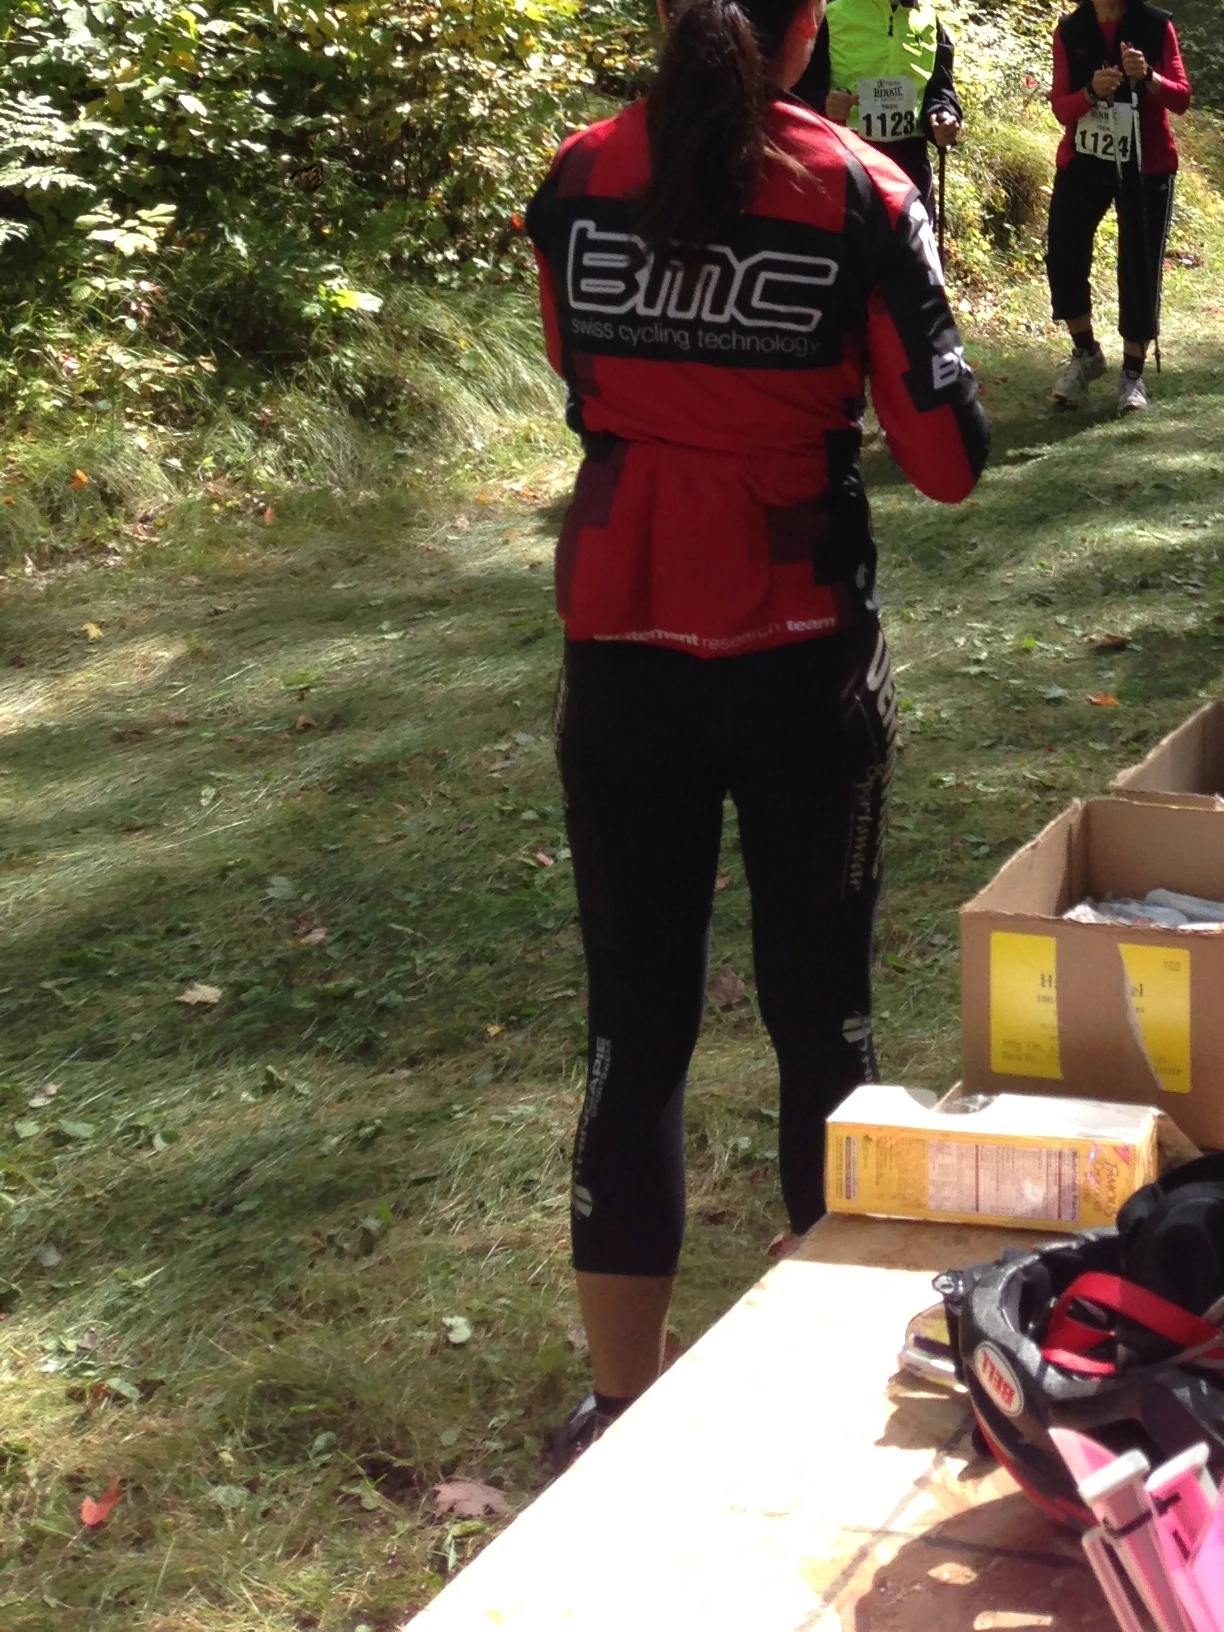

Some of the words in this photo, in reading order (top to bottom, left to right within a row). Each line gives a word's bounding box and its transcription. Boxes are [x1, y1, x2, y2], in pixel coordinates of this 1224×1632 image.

[862, 110, 915, 138] 1123
[1079, 129, 1129, 158] 1124
[571, 318, 614, 340] swiss
[619, 322, 691, 351] cycling
[697, 328, 822, 358] technology
[701, 621, 782, 651] research
[785, 615, 836, 633] team
[981, 1351, 1016, 1407] BELL
